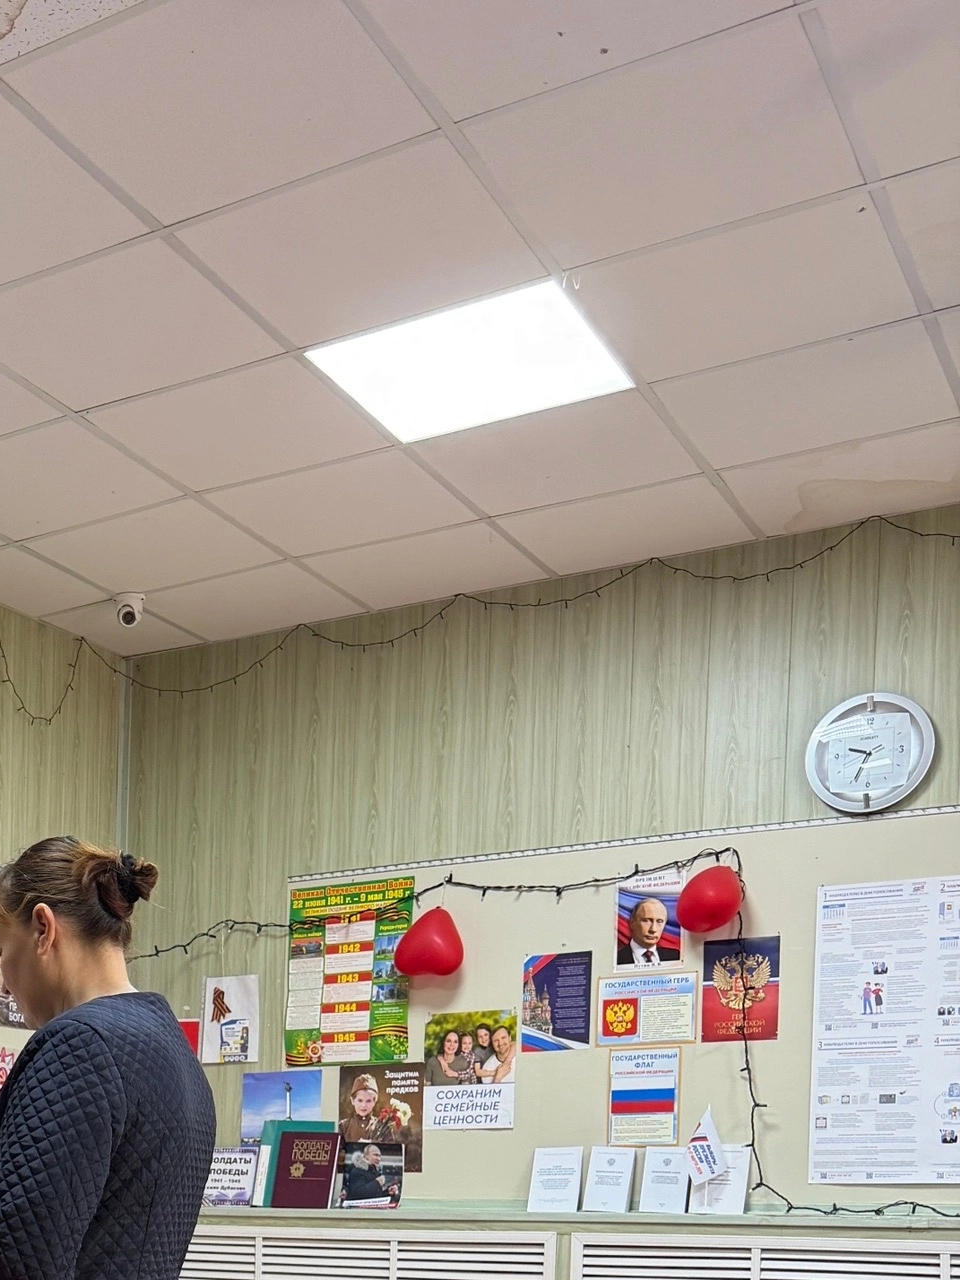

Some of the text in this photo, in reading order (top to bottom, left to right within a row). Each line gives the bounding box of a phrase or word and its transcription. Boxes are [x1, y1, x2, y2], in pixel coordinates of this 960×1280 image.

[866, 717, 875, 726] 12
[898, 744, 905, 754] 3
[291, 879, 414, 900] Великая Отечественная Война
[940, 883, 946, 892] 2
[292, 899, 303, 909] 22
[304, 898, 326, 908] июня
[327, 896, 344, 906] 1941
[360, 893, 367, 902] 9
[367, 893, 383, 901] мая
[385, 889, 403, 900] 1945
[338, 943, 361, 954] 1942
[337, 973, 359, 984] 1943
[604, 976, 690, 989] ГОСУДАРСТВЕННЫЙ ГЕРБ
[335, 1003, 357, 1013] 1944
[717, 1026, 762, 1035] ФЕДЕЦИИ
[334, 1033, 356, 1043] 1945
[933, 1037, 940, 1045] 4
[818, 1041, 823, 1049] 3
[611, 1052, 678, 1062] ГОСУДАРСТВЕННЫЙ
[634, 1061, 655, 1069] ФЛАГ
[384, 1070, 420, 1080] Защитим
[391, 1079, 420, 1088] память
[386, 1086, 420, 1096] предков
[436, 1088, 502, 1101] СОХРАНИМ
[434, 1099, 500, 1113] СЕМЕЙНЫЕ
[433, 1114, 499, 1127] ЦЕННОСТИ
[293, 1140, 332, 1150] СОЛДАТЫ
[291, 1149, 331, 1161] ПОБЕДЫ
[691, 1144, 705, 1164] РОССИИ
[213, 1156, 252, 1165] ОЛДАТЫ
[698, 1144, 716, 1175] ПРЕЗИДЕНТА
[210, 1167, 249, 1177] ПОБЕДЫ
